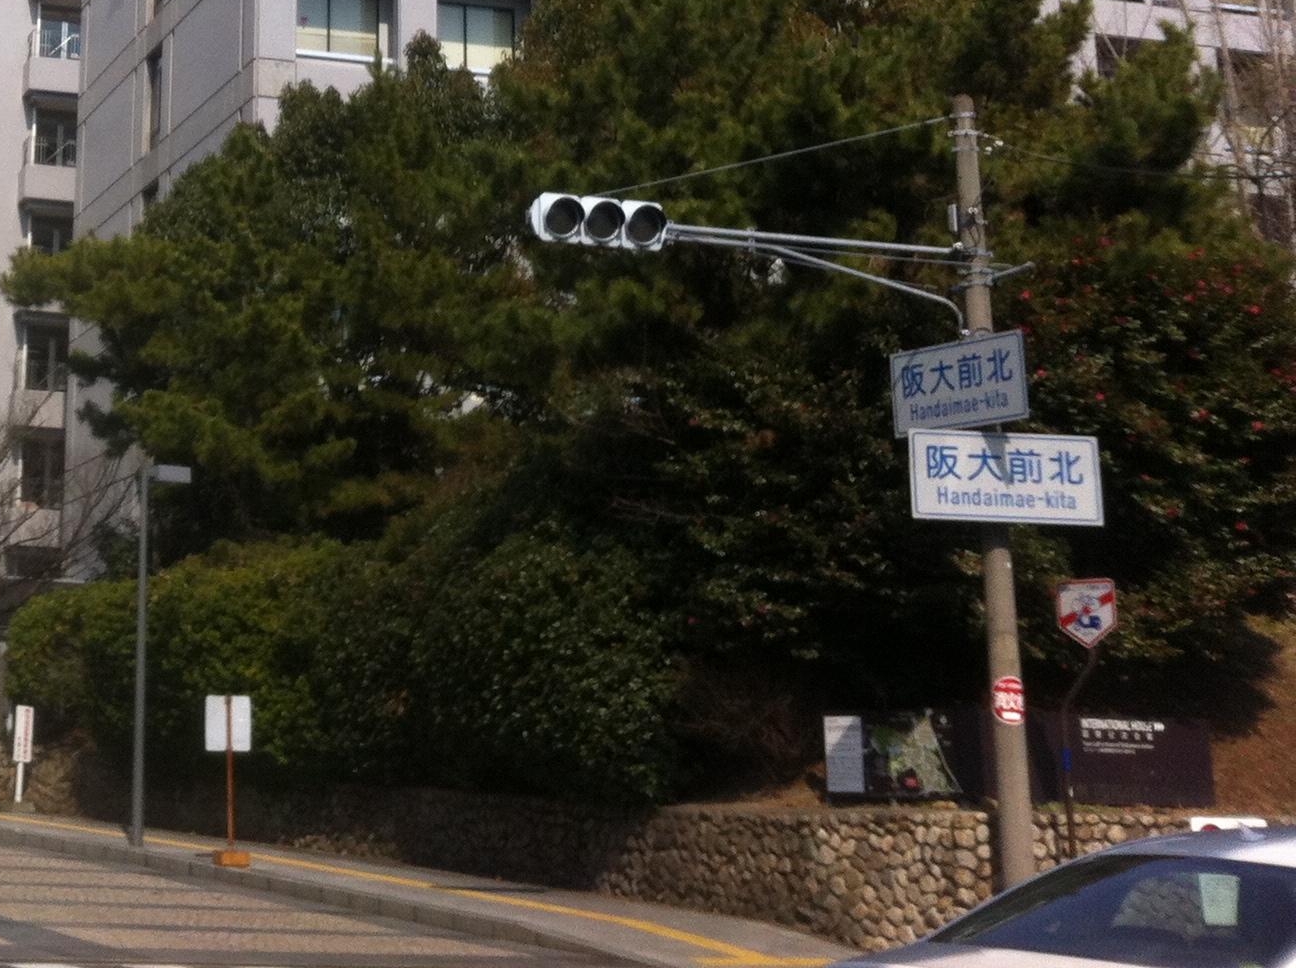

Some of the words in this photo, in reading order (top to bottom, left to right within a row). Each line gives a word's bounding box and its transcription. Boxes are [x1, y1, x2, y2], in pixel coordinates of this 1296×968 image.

[900, 348, 1014, 399] 阪大前北
[910, 392, 1009, 421] Handaimae-kita
[926, 445, 1084, 485] 阪大前北
[937, 487, 1077, 511] Handaimae-kita
